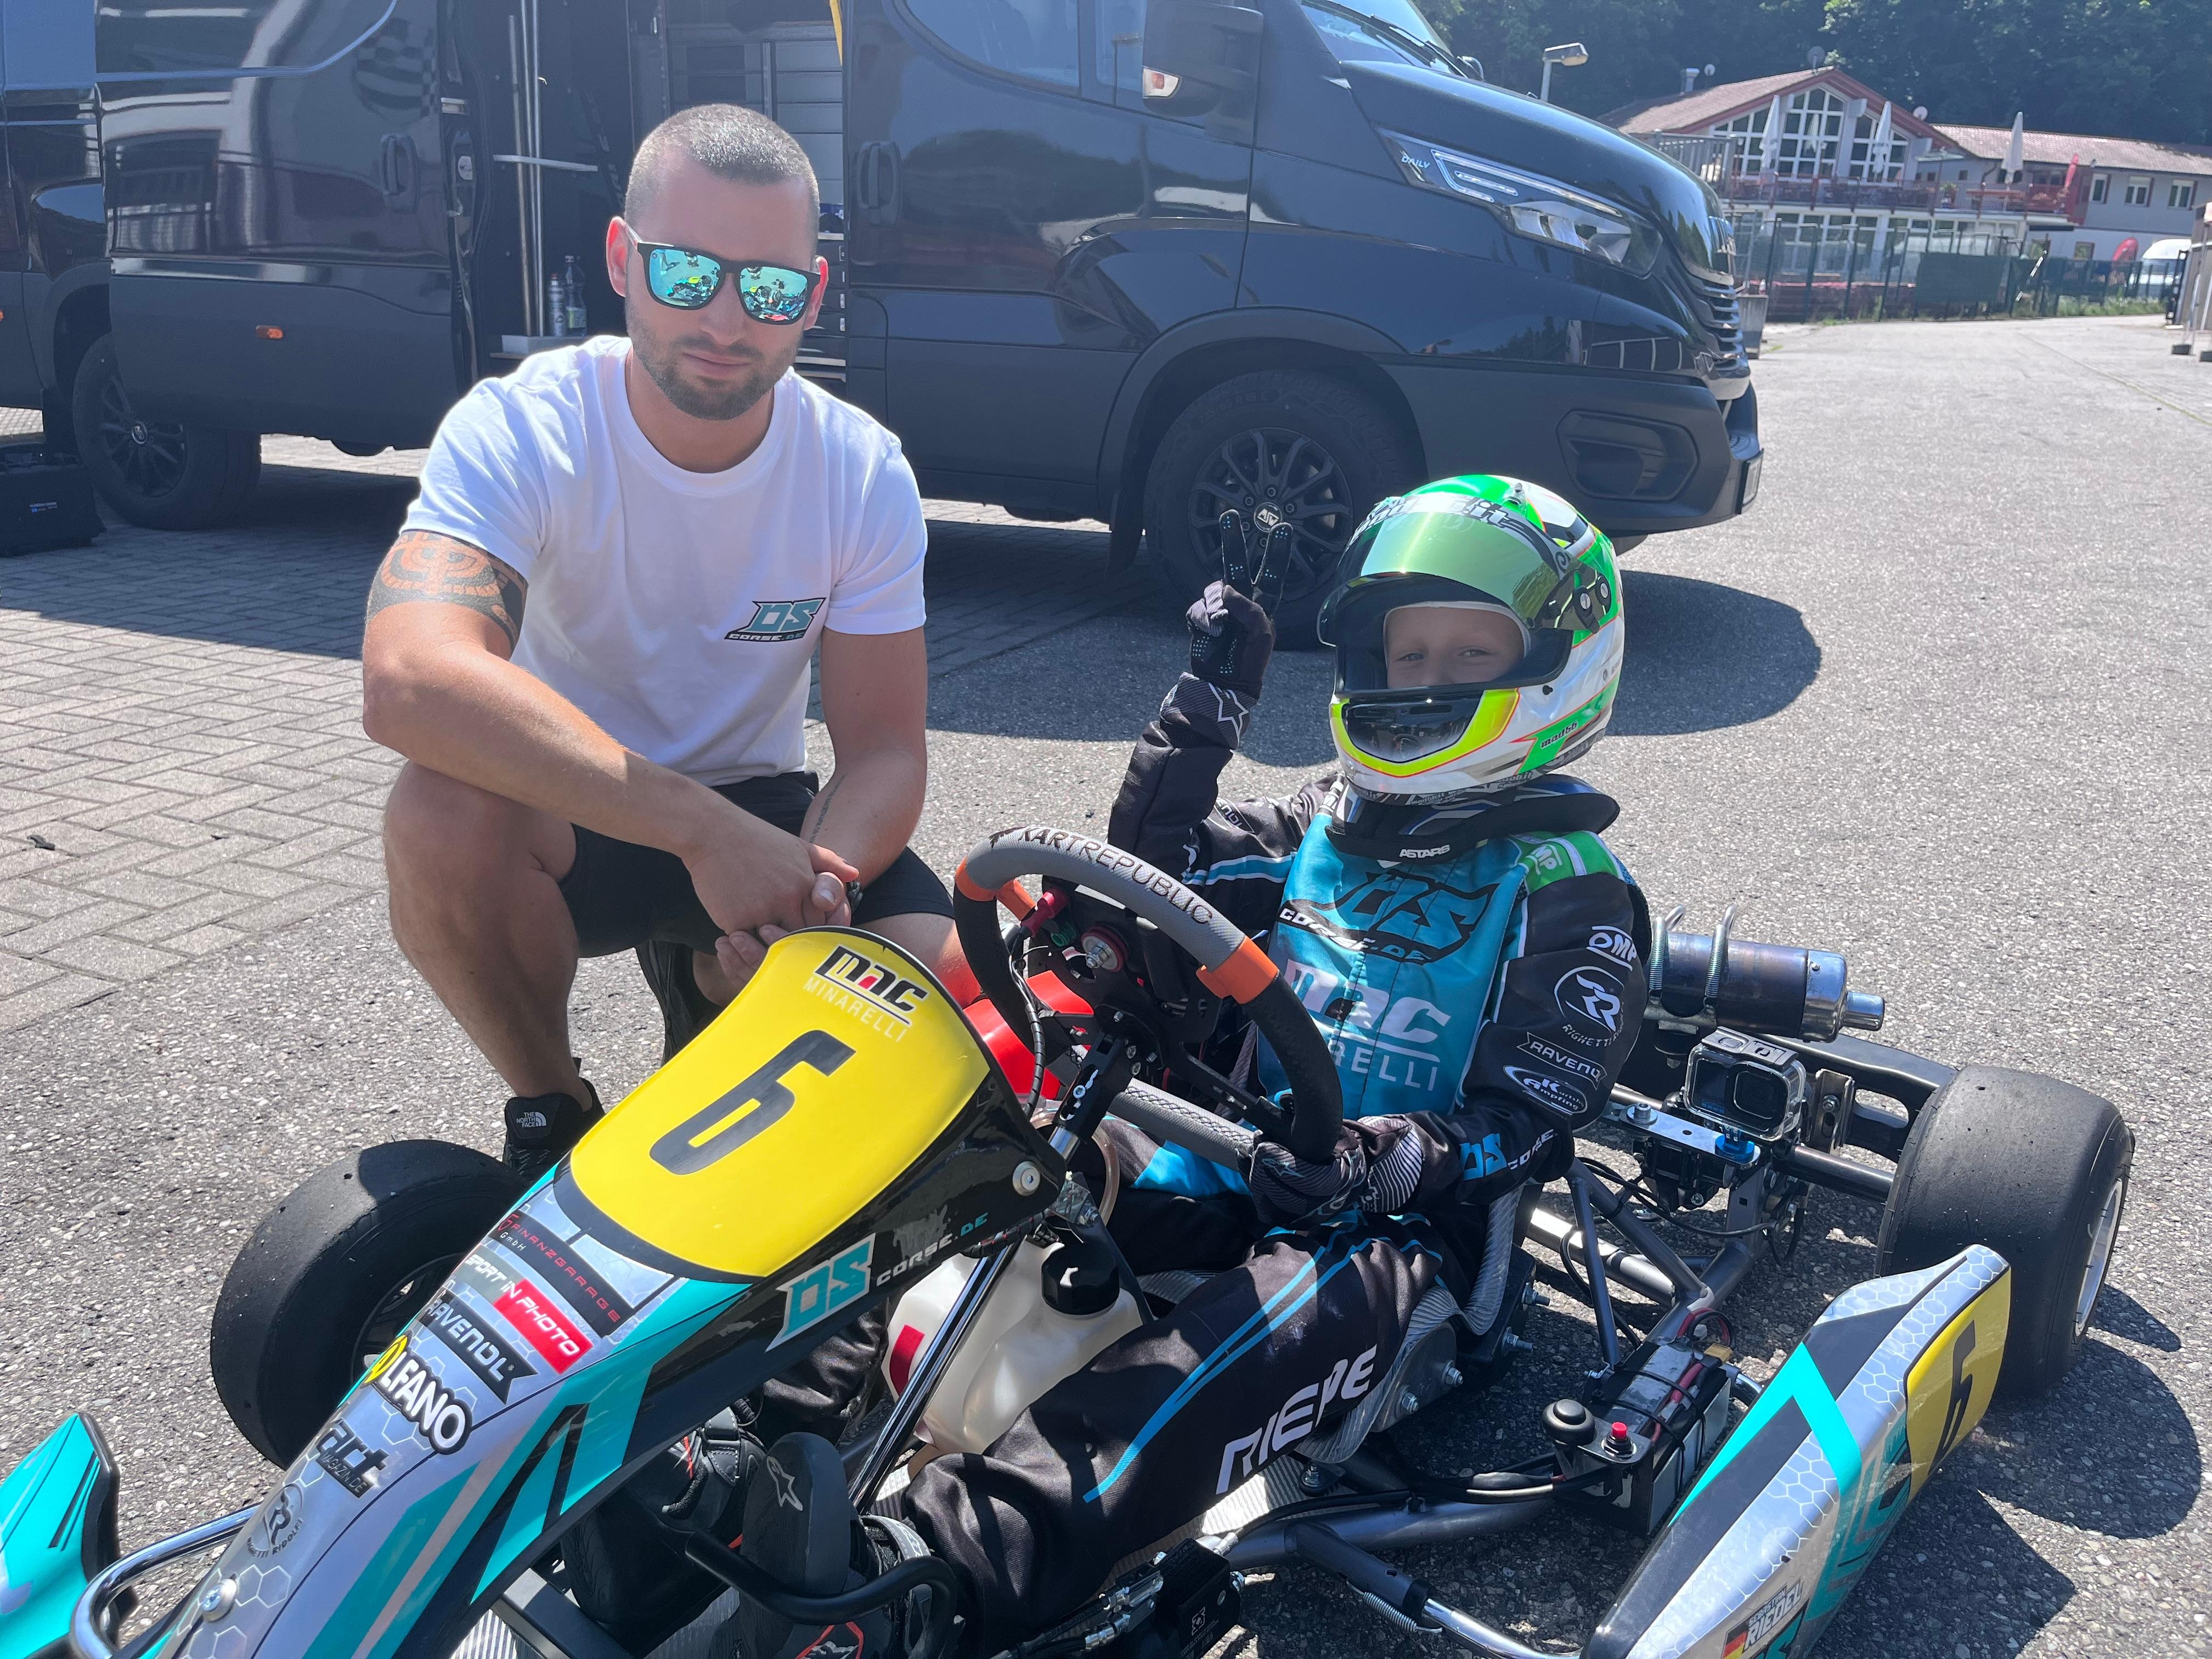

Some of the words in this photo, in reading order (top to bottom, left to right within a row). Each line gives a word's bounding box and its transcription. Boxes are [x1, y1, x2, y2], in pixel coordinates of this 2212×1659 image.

[742, 600, 823, 632] DS
[1018, 827, 1213, 925] KARTREPUBLIC
[1399, 844, 1451, 859] ASTARS
[1587, 932, 1638, 963] OMP
[803, 977, 908, 1043] MINARELLI
[1529, 1041, 1601, 1082] RAVENOL
[649, 1029, 857, 1175] 6
[500, 1231, 527, 1251] GmbH
[465, 1254, 507, 1282] SPORT
[516, 1296, 580, 1356] PHOTO
[776, 1237, 873, 1342] DS
[426, 1296, 507, 1381] RAVENOL
[1927, 1319, 1976, 1476] 6
[272, 1516, 303, 1555] RIDOLFI
[1743, 1580, 1803, 1651] RIEDEL
